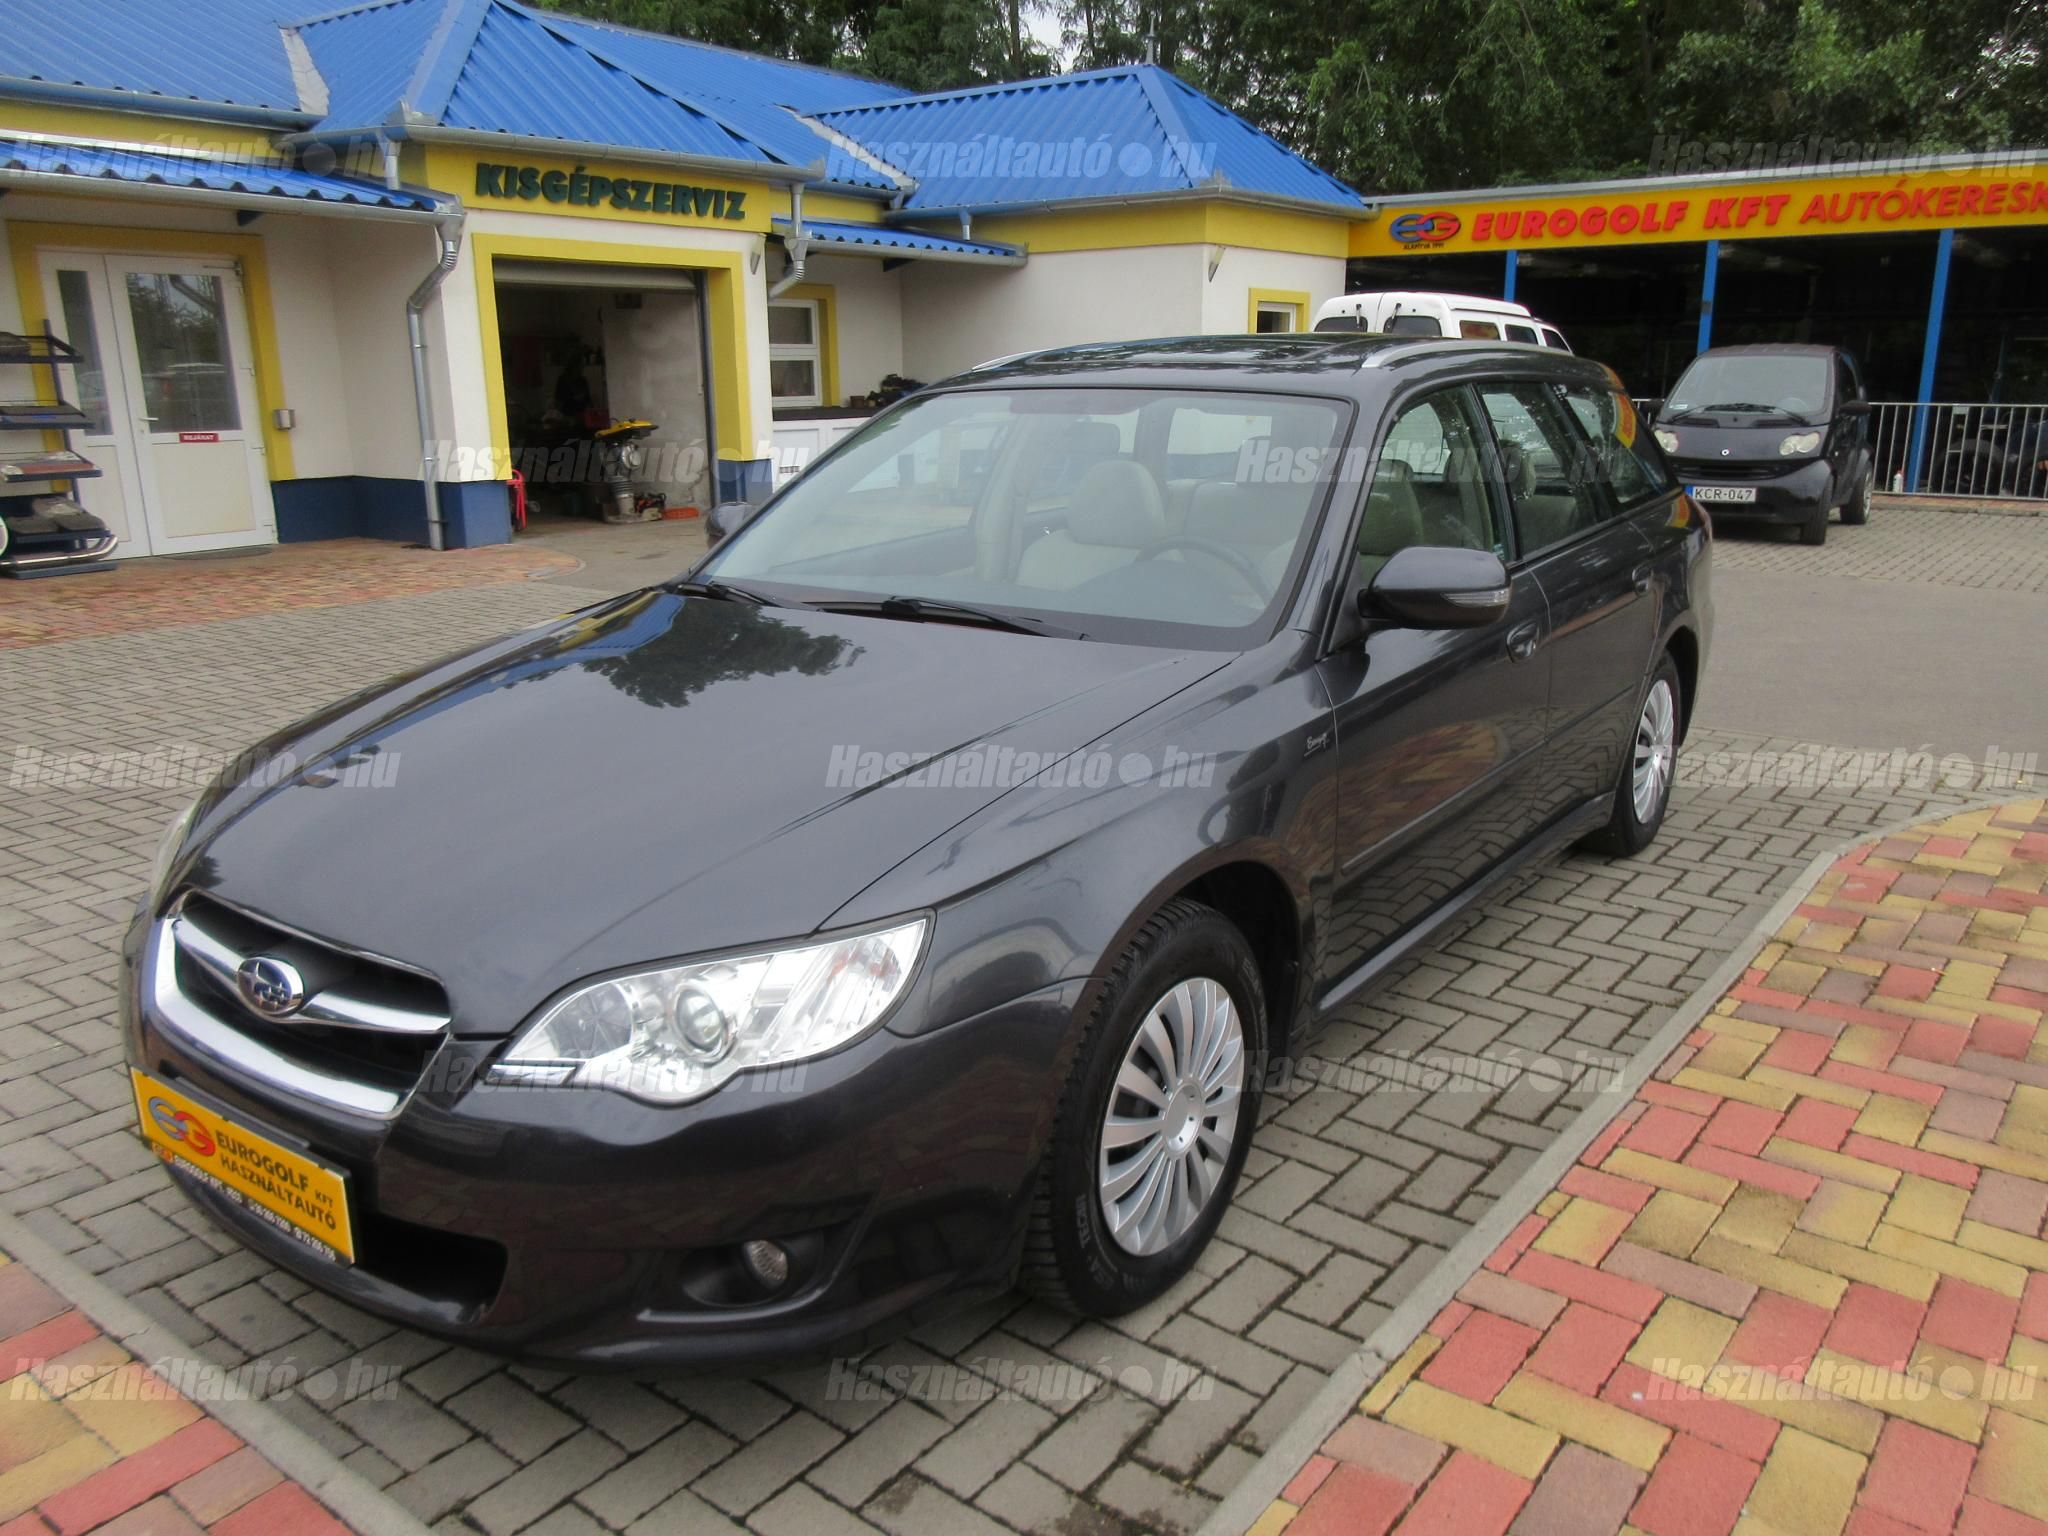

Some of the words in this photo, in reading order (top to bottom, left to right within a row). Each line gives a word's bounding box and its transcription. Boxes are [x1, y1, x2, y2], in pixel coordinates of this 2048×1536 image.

[475, 163, 746, 220] KISGÉPSZERVIZ
[1471, 201, 1689, 241] EUROGOLF
[1703, 194, 1790, 229] KFT
[1695, 488, 1752, 500] KCR-047
[216, 1130, 308, 1192] EUROGOLF
[314, 1190, 334, 1208] KFT
[220, 1154, 337, 1231] HASZNÁLTAUTÓ
